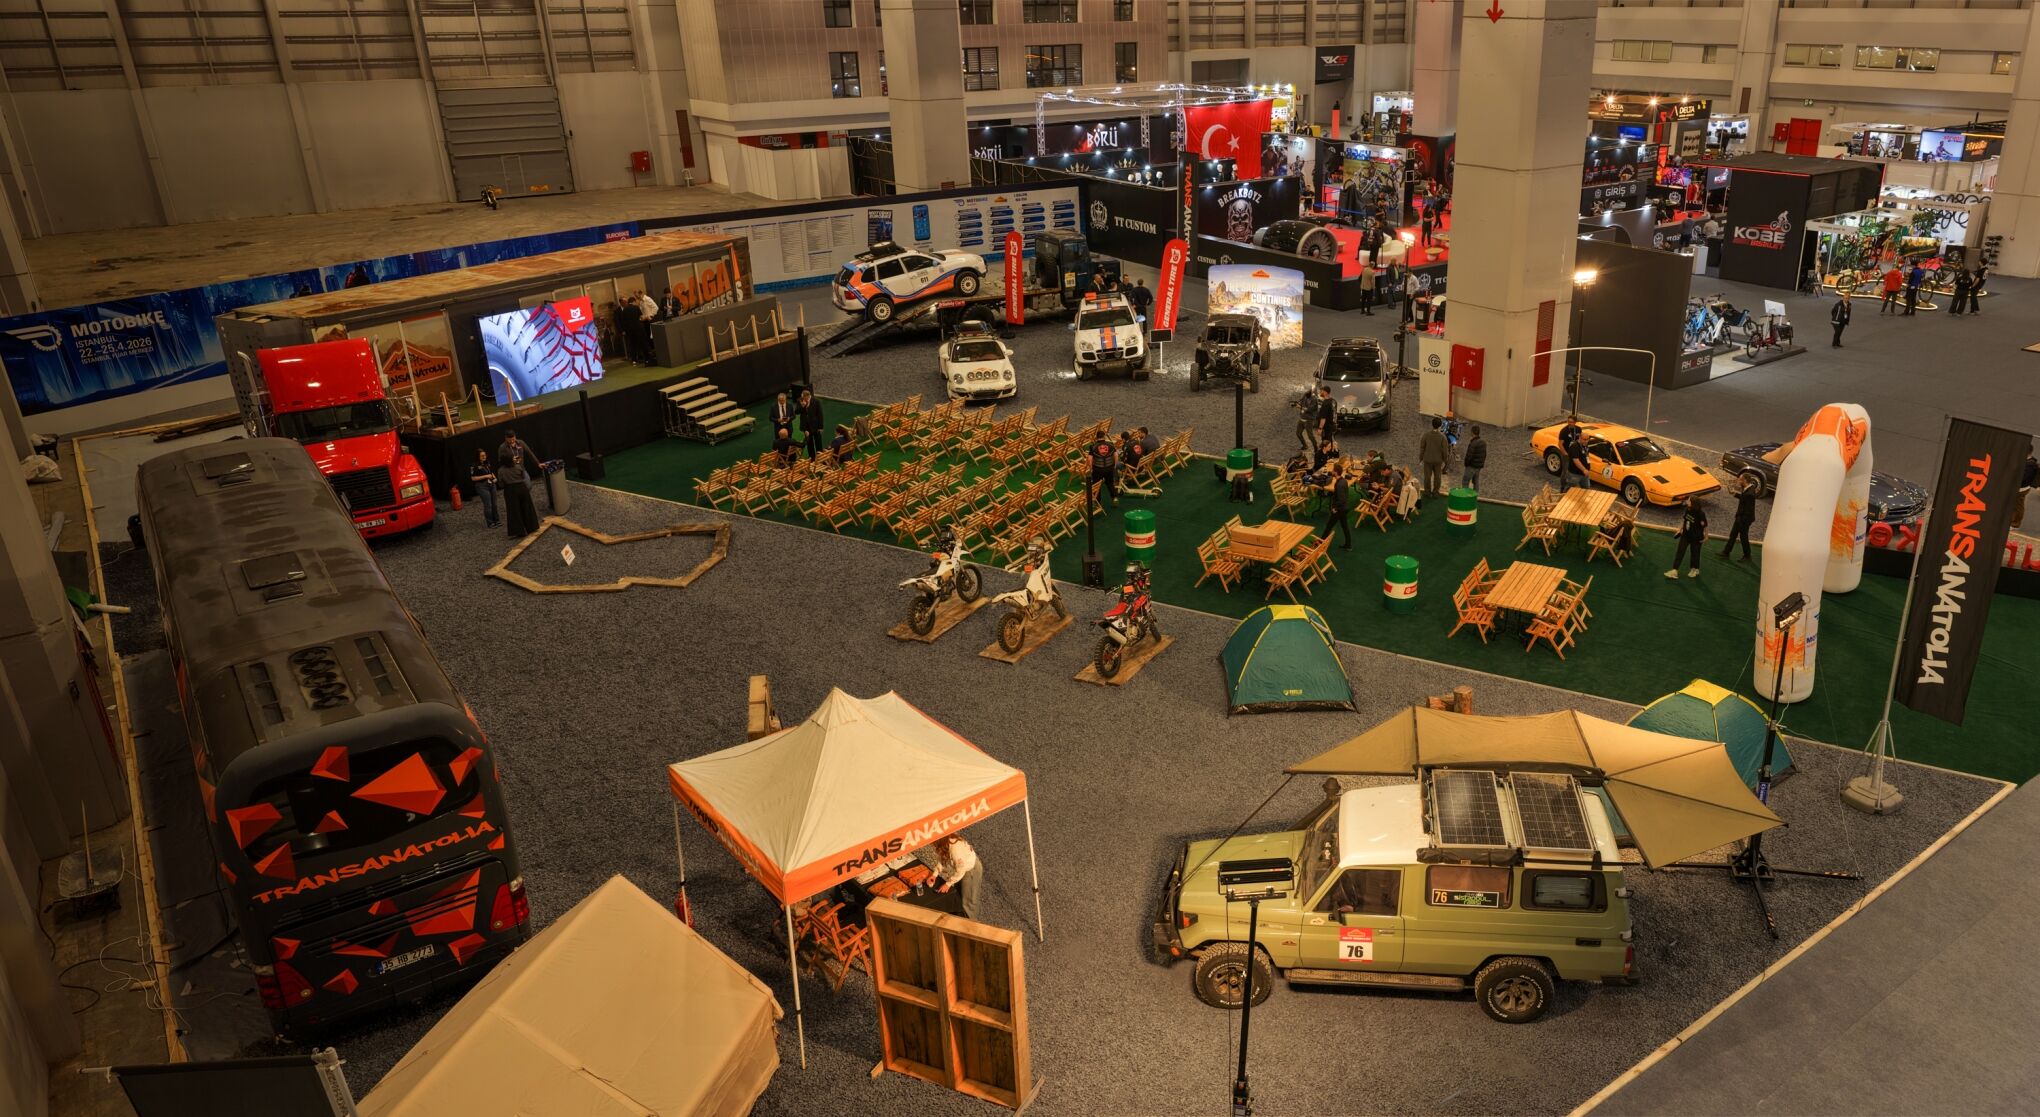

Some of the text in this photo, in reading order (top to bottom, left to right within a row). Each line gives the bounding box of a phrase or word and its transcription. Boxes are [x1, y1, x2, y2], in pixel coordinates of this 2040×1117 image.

[1679, 105, 1695, 114] DELTA
[1087, 126, 1118, 148] BÖRÜ
[1217, 187, 1263, 209] BREAKBOYZ
[1114, 216, 1157, 235] TT CUSTOM
[1734, 226, 1787, 244] KOBE
[1197, 255, 1217, 265] CUSTOM
[1169, 266, 1178, 287] TIRE
[1163, 286, 1174, 328] GENERAL
[1250, 293, 1291, 307] CONTINUES
[70, 310, 166, 338] MOTOBIKE
[75, 335, 118, 349] ISTANBUL
[1917, 453, 1992, 684] TRANSANATOLIA
[833, 797, 991, 867] TRANSANATOLIA
[252, 820, 496, 904] TRANSANATOLIA
[1434, 891, 1448, 903] 76
[382, 945, 433, 969] 35 HB 2773
[1347, 945, 1364, 958] 76
